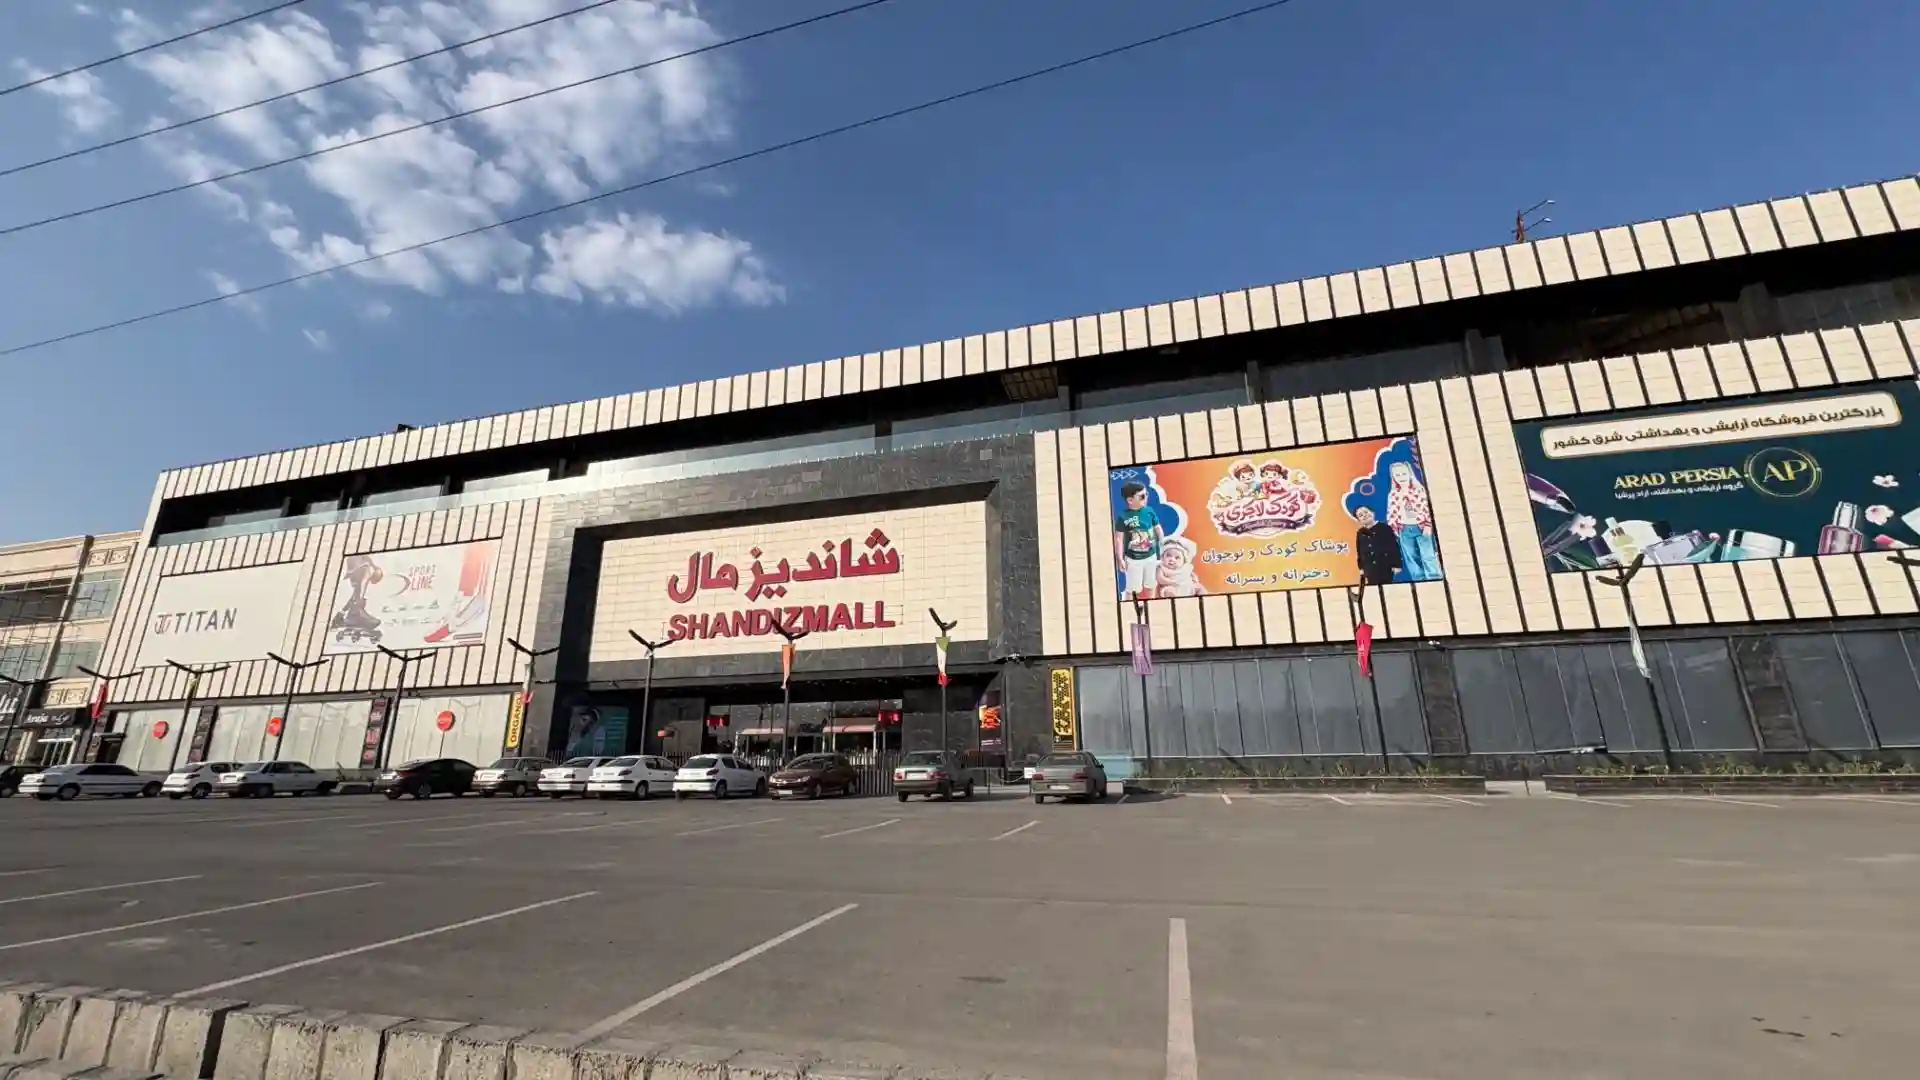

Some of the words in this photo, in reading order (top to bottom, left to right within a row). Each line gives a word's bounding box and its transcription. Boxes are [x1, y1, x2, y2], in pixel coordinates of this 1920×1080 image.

[1751, 412, 1818, 429] فروشگاه
[1592, 431, 1623, 446] شرق
[1624, 427, 1689, 442] بهداشتی
[1691, 427, 1700, 436] و
[1553, 435, 1590, 450] کشور
[1614, 472, 1666, 489] ARAD
[1670, 466, 1742, 484] PERSIA
[1202, 549, 1244, 563] نوجوان
[1248, 550, 1255, 559] و
[1260, 542, 1298, 558] کودک
[408, 564, 436, 577] SPORT
[744, 528, 901, 602] شاندیز
[411, 575, 433, 591] LINE
[667, 551, 739, 603] مال
[174, 608, 237, 634] TITAN
[667, 601, 896, 641] SHANDIZMALL
